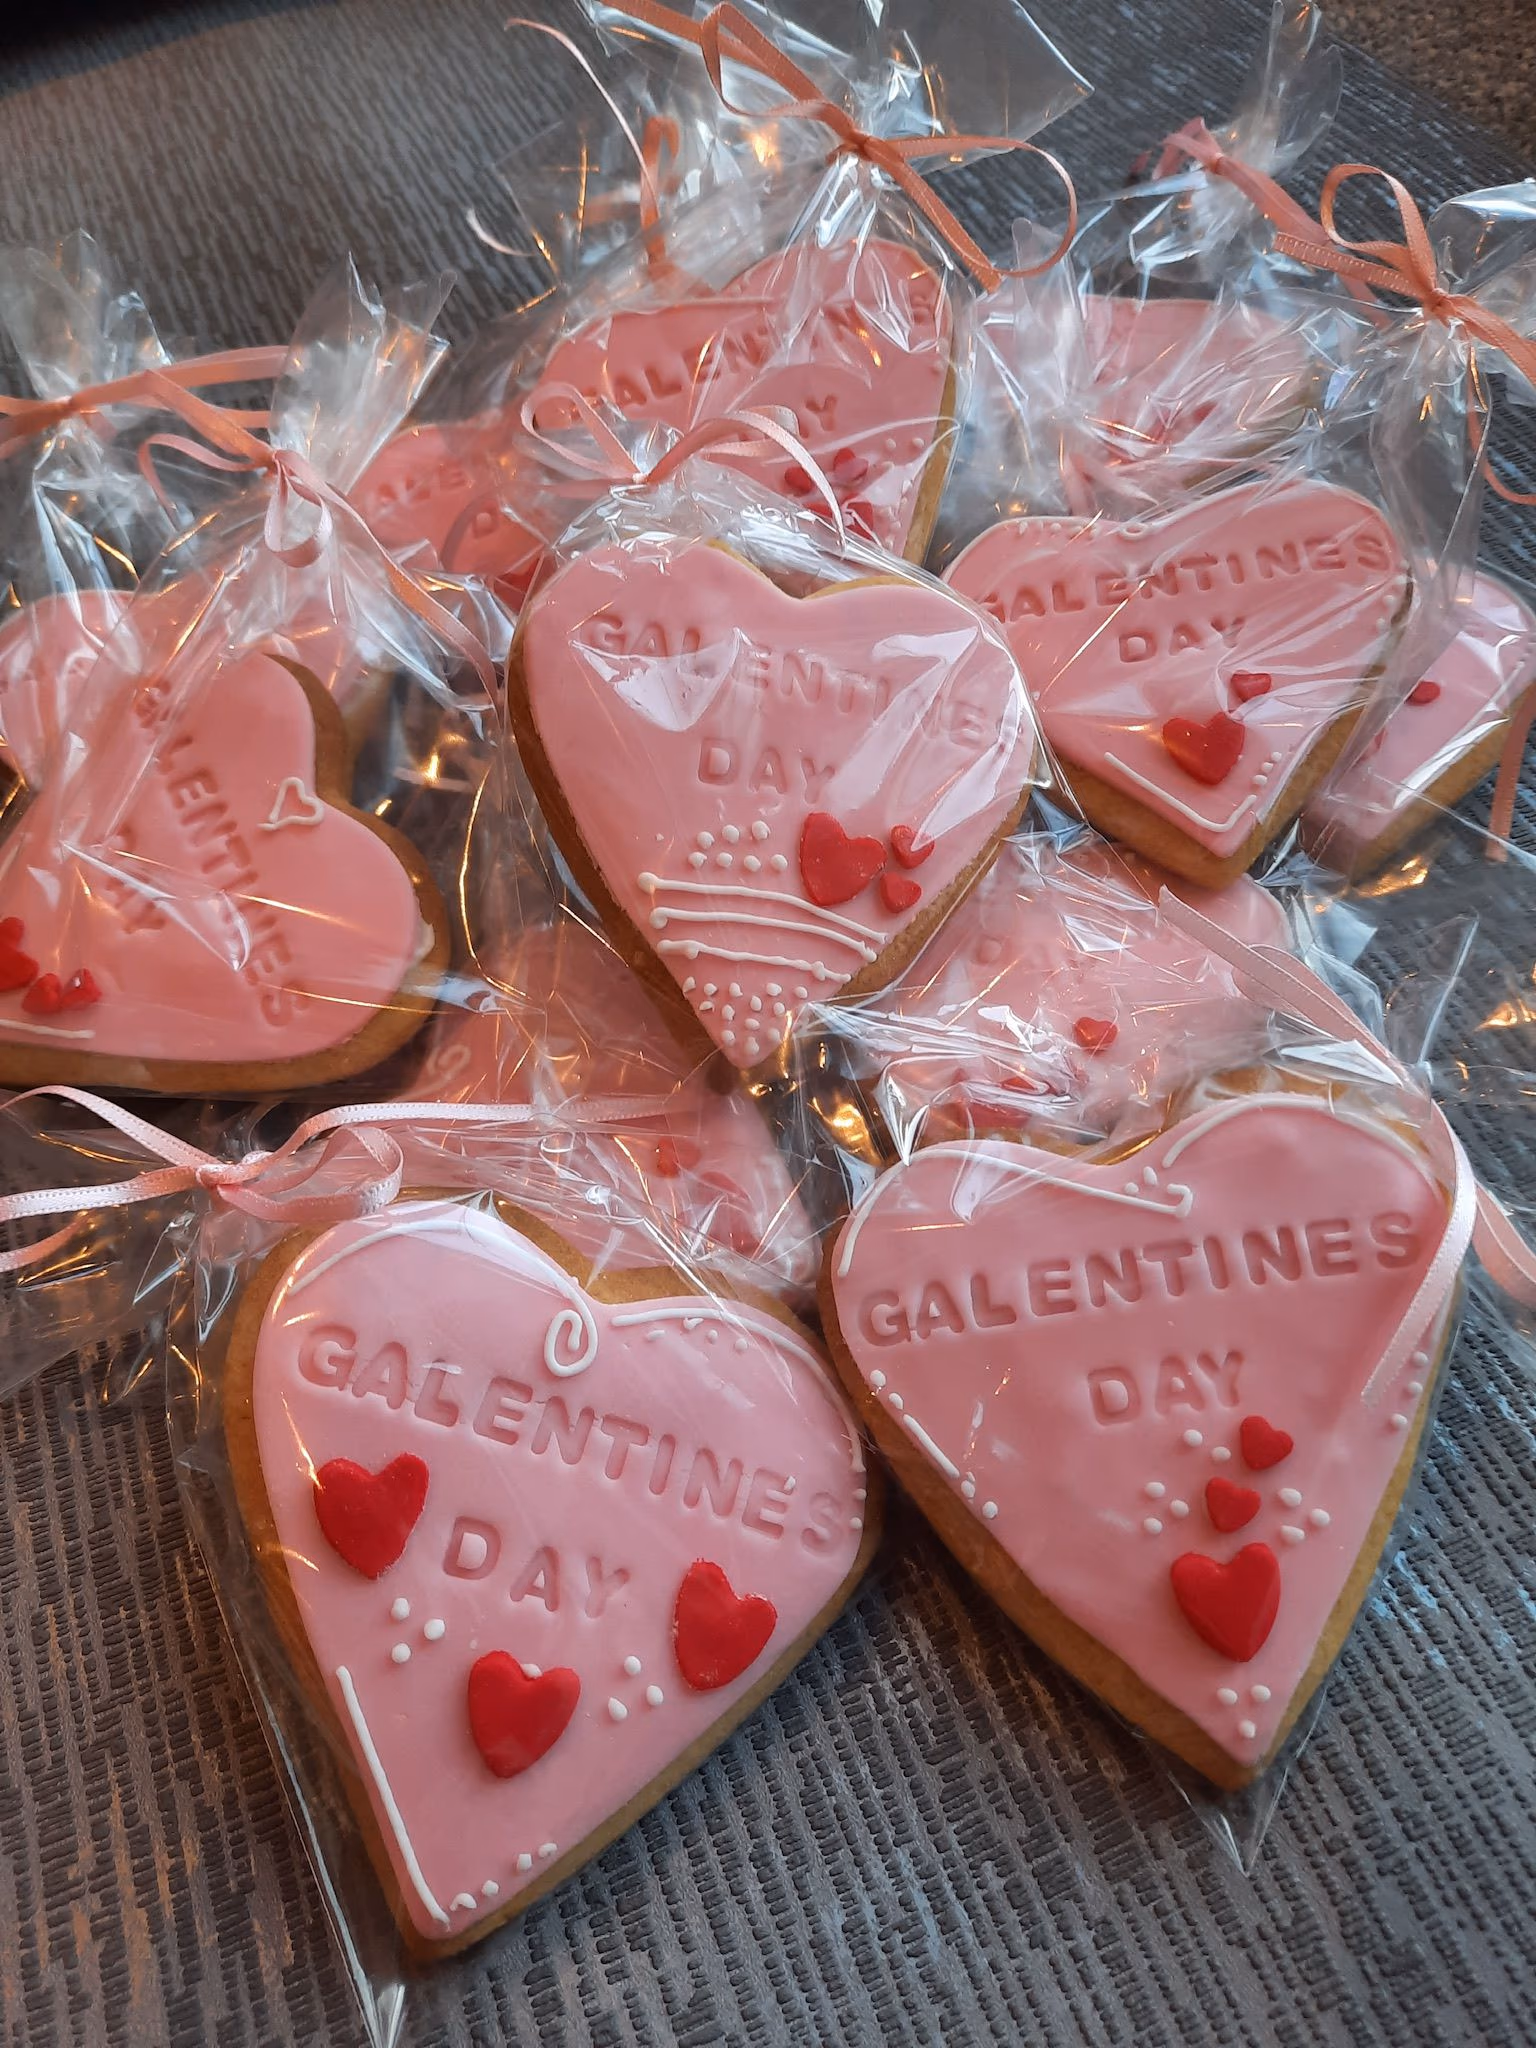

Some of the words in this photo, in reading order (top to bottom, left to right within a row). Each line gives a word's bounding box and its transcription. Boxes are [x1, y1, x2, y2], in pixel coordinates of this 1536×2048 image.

[1118, 615, 1246, 664] DAY
[699, 737, 836, 806] DAY
[859, 1210, 1422, 1347] GALENTINES
[1087, 1350, 1247, 1426] DAY
[299, 1324, 844, 1554] GALENTINES
[443, 1516, 632, 1618] DAY
